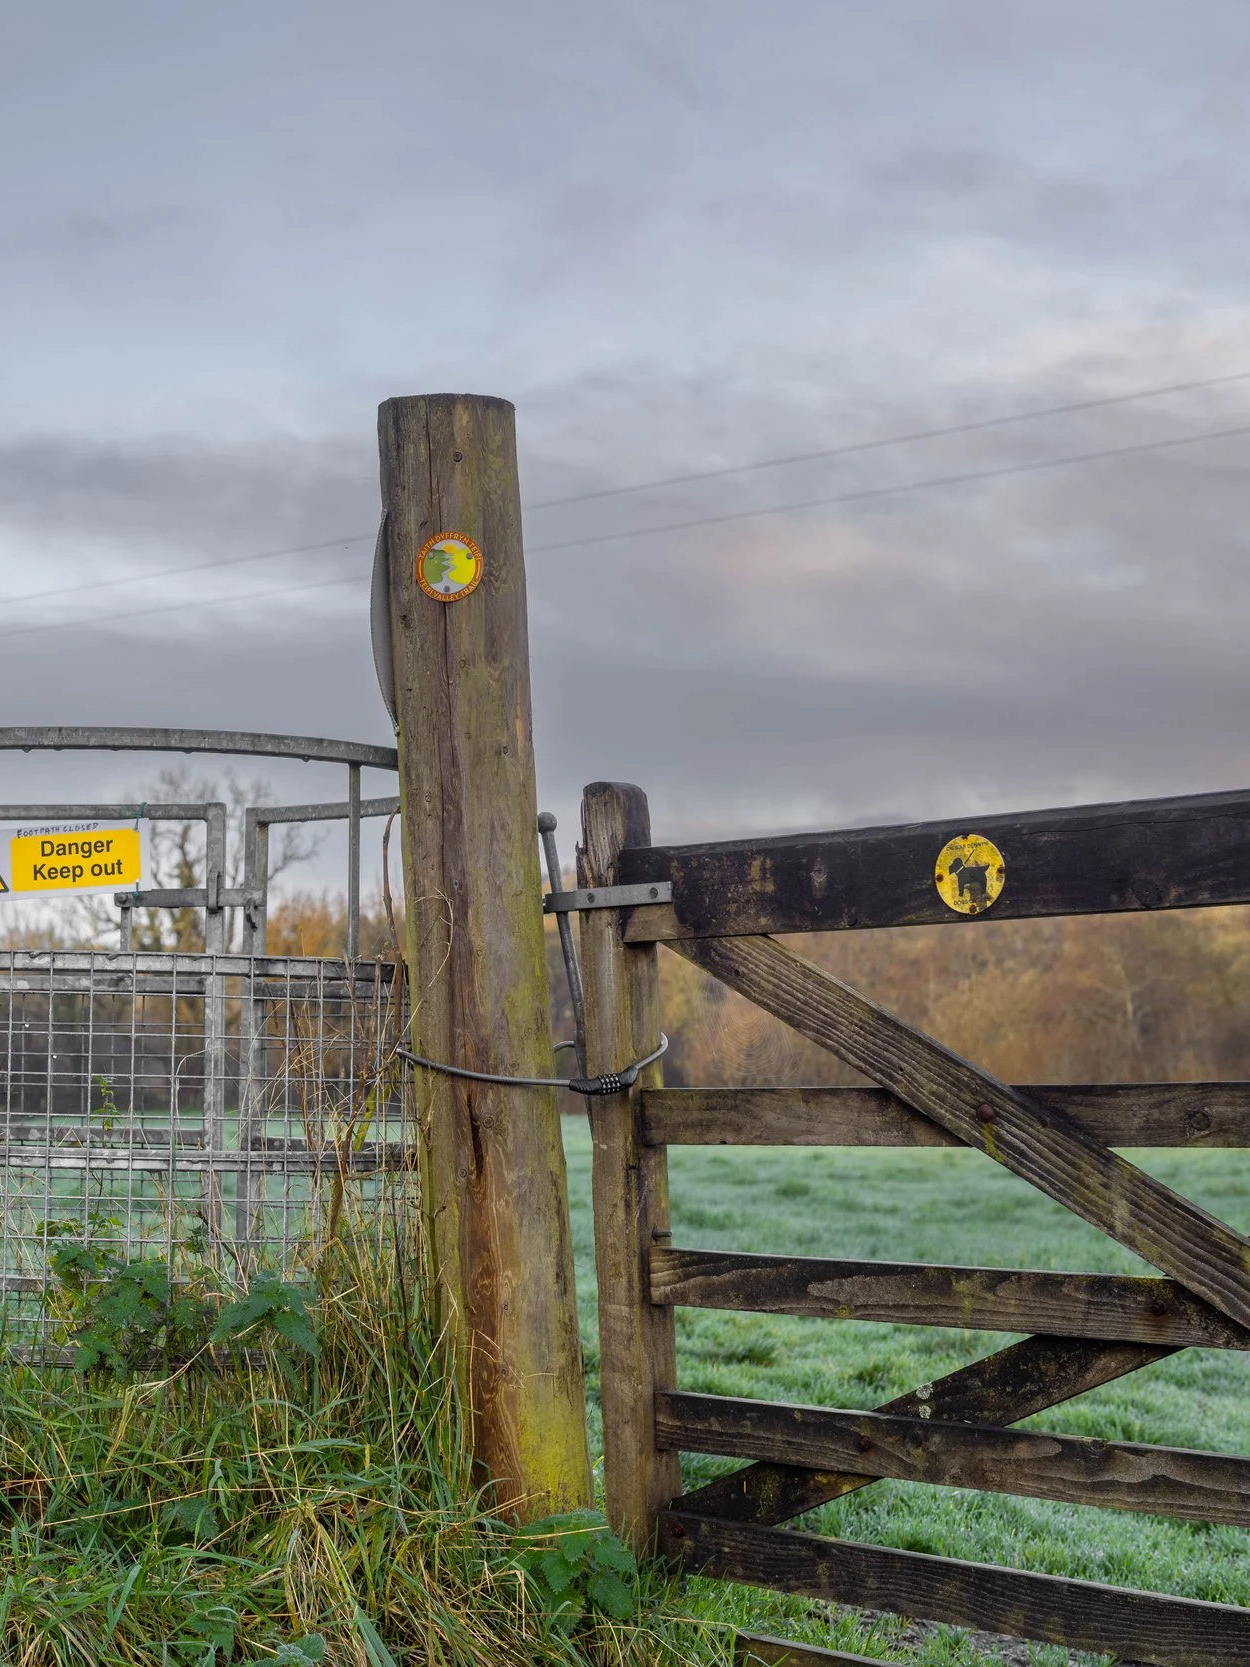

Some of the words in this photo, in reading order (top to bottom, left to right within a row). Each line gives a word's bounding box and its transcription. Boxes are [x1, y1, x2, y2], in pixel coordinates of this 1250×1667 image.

[419, 540, 436, 560] TAITH
[435, 532, 469, 545] DYFFRYN
[469, 543, 482, 561] TEIFI
[420, 577, 436, 596] TEIFI
[433, 591, 460, 601] VALLEY
[460, 579, 480, 598] TRAIL
[16, 825, 60, 839] FOOTPATH
[63, 822, 99, 833] CLOSED
[40, 839, 114, 859] Danger
[33, 863, 84, 884] Keep
[90, 859, 124, 877] out
